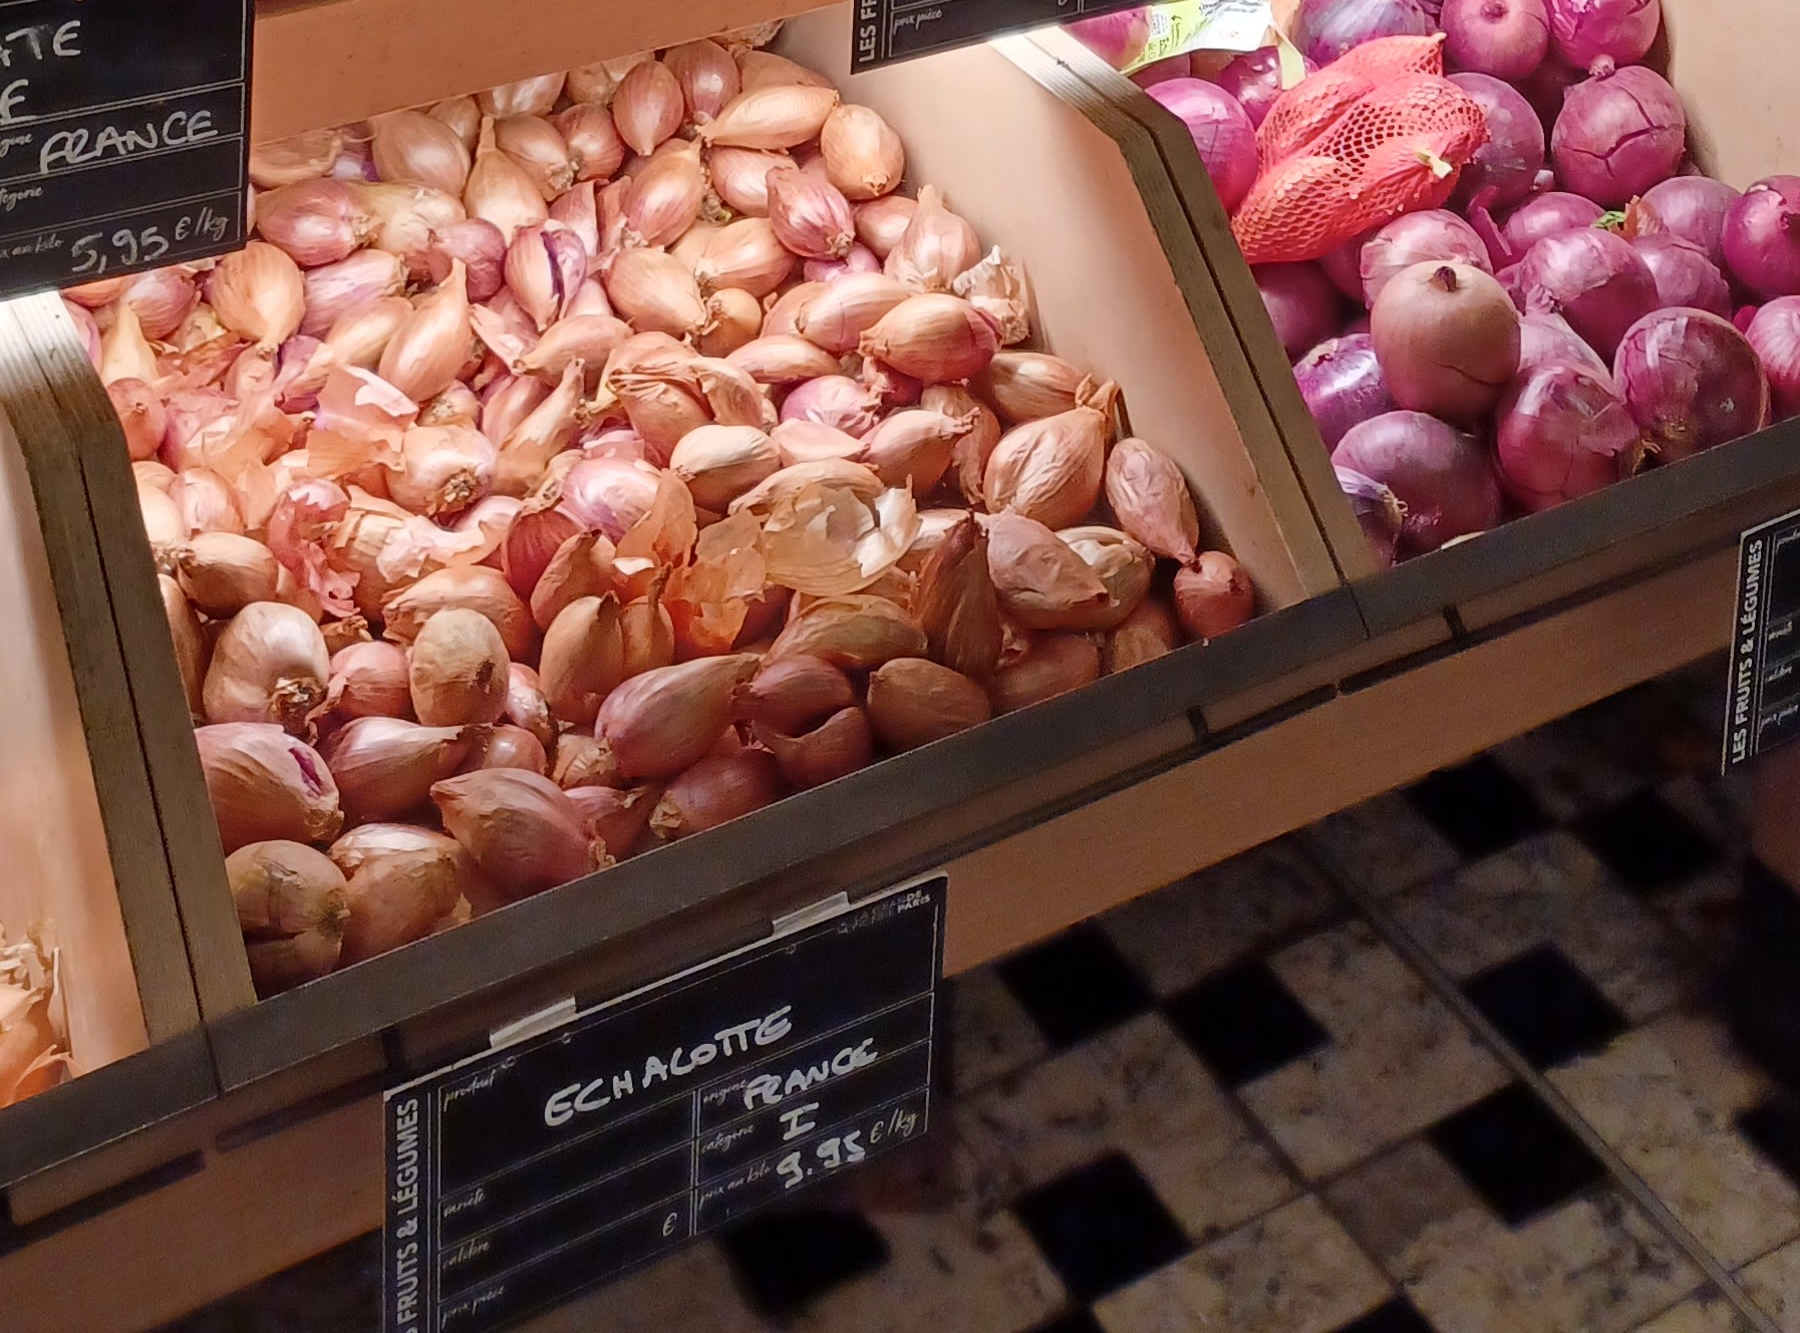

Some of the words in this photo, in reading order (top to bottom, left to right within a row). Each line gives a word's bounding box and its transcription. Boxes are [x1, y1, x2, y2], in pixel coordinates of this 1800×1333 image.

[859, 23, 876, 63] LES
[39, 110, 219, 175] FRANCE
[71, 225, 170, 275] 5,95
[175, 206, 230, 242] €/kg
[1740, 539, 1764, 635] LÉGUMES
[1741, 636, 1754, 655] &
[1735, 654, 1753, 726] FRUITS
[1732, 727, 1748, 764] LES
[443, 1069, 497, 1113] produit
[544, 1005, 792, 1127] ECHALOTTE
[743, 1038, 878, 1110] FRANCE
[775, 1130, 866, 1189] 9.95
[869, 1106, 917, 1145] €/kg
[779, 1101, 820, 1141] I
[391, 1098, 418, 1215] LÉGUMES
[396, 1216, 418, 1240] &
[442, 1238, 491, 1270] calibre
[662, 1212, 678, 1238] €
[397, 1241, 418, 1326] FRUITS
